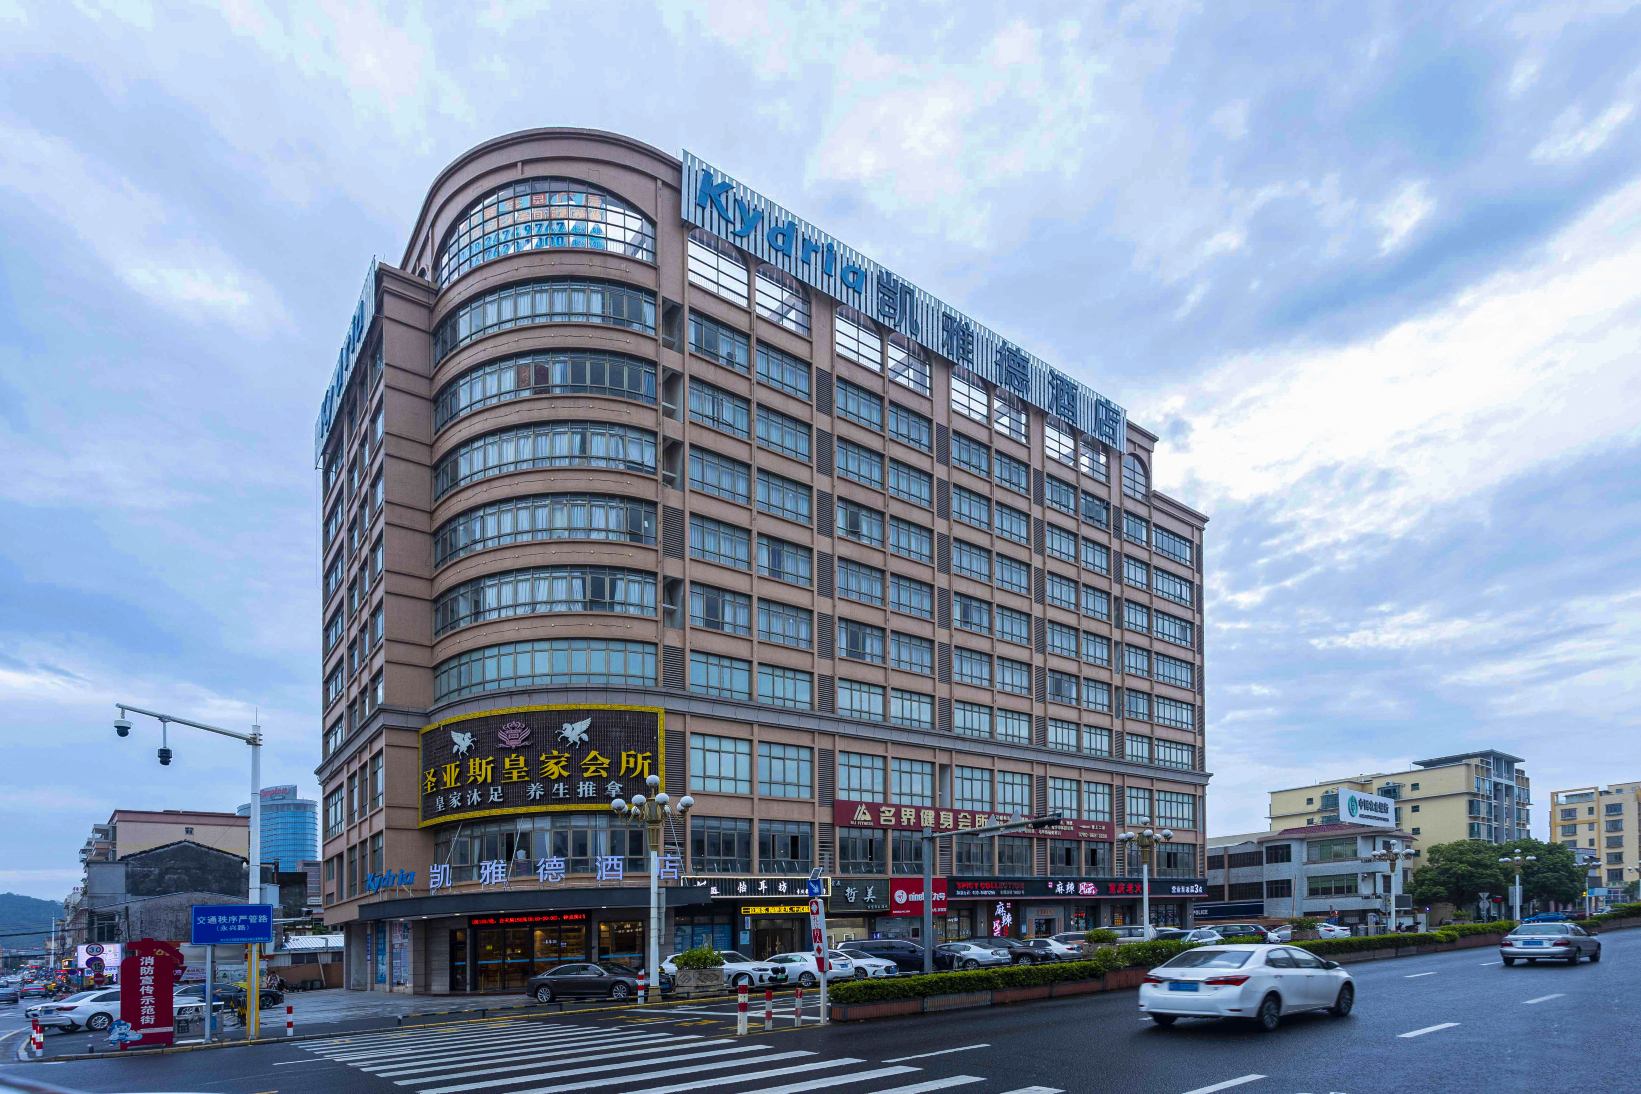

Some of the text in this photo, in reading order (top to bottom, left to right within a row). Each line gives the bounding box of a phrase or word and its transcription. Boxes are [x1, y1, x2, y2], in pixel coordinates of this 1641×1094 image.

[697, 168, 1121, 450] Kydria 凯雅德酒店
[423, 750, 652, 796] 圣亚斯皇家会所
[435, 781, 624, 811] 皇家沐足 养生推拿
[879, 806, 989, 830] 名界健身会所
[366, 868, 416, 894] Kydria
[430, 854, 680, 889] 凯雅德酒店
[844, 886, 877, 903] 哲美
[196, 914, 268, 925] 交通秩序严管路
[140, 956, 155, 1025] 消防宣传示范街
